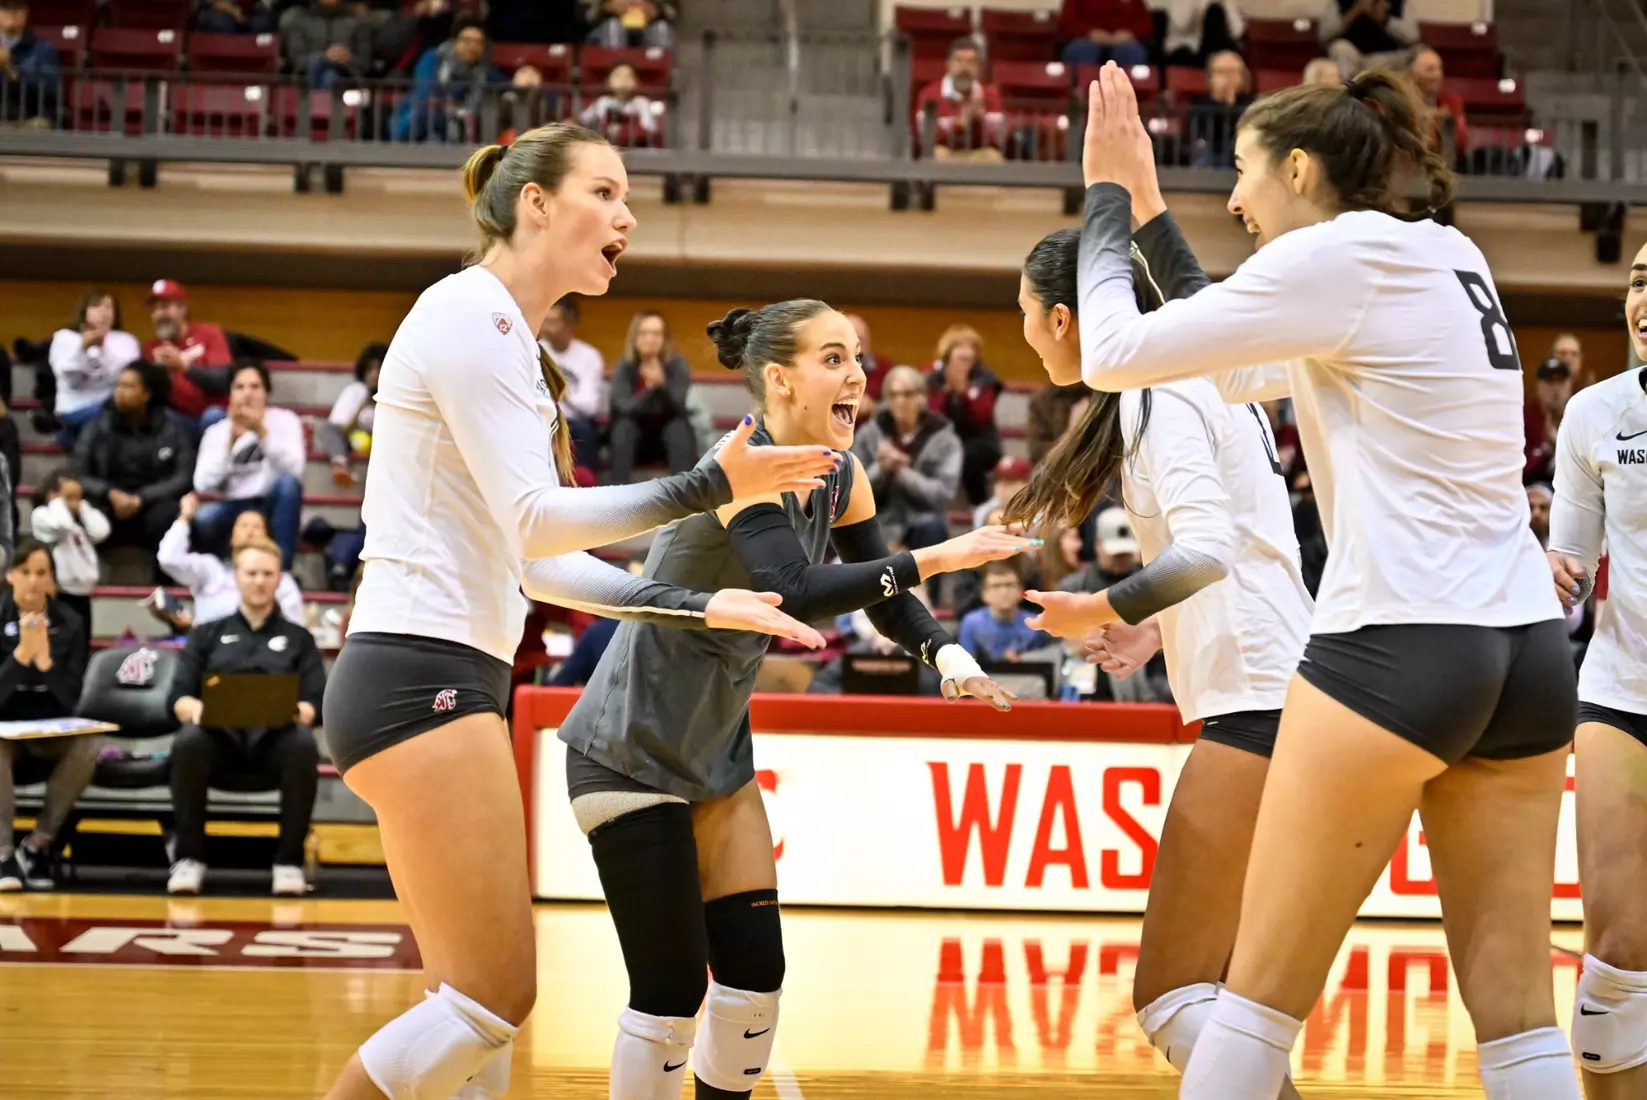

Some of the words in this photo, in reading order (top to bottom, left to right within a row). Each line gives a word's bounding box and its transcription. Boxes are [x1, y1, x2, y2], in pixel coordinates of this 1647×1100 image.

[1453, 269, 1520, 371] 8
[1617, 449, 1647, 465] WAS
[0, 925, 402, 958] RS
